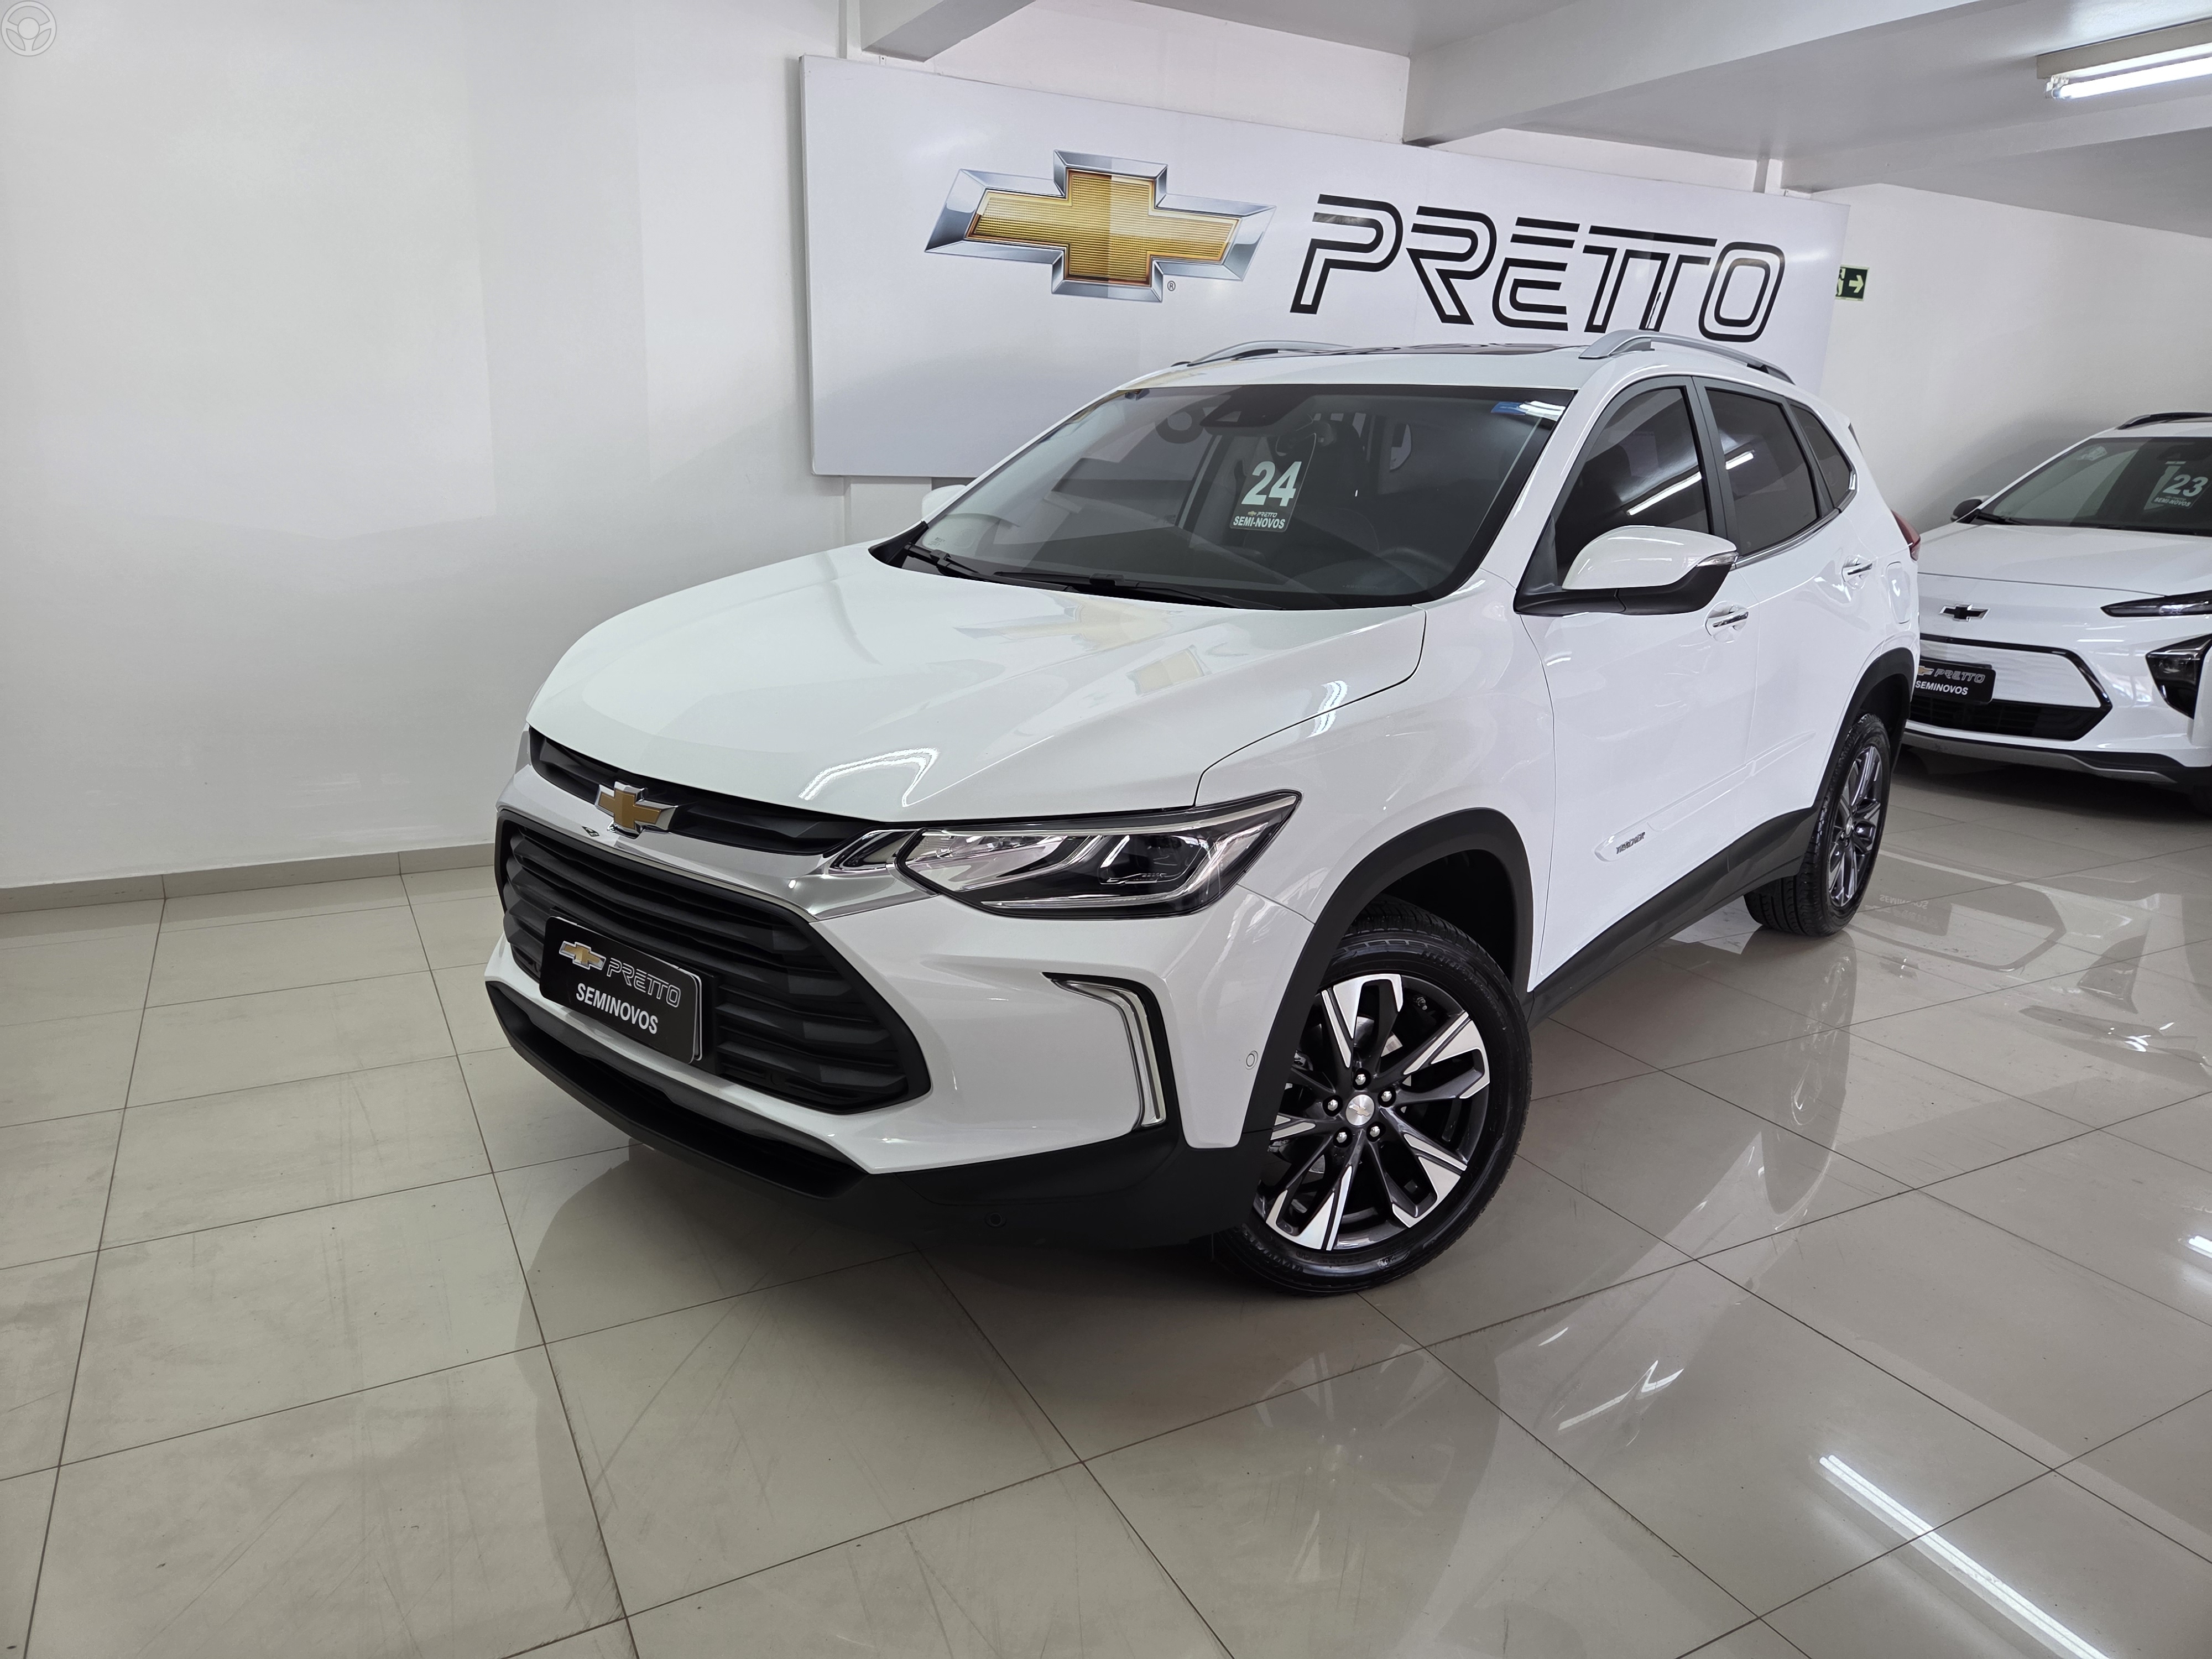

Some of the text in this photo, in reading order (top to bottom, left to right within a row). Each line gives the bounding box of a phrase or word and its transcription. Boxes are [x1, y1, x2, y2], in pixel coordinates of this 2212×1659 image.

[1290, 194, 1785, 343] PRETTO
[1241, 461, 1302, 507] 24
[2162, 474, 2208, 497] 23
[1233, 516, 1285, 529] SEMI-NOVOS
[1915, 681, 1969, 695] SEMINOVOS
[1934, 669, 1985, 684] PRETTO
[607, 957, 681, 1008] PRETTO
[576, 983, 658, 1034] SEMINOVOS
